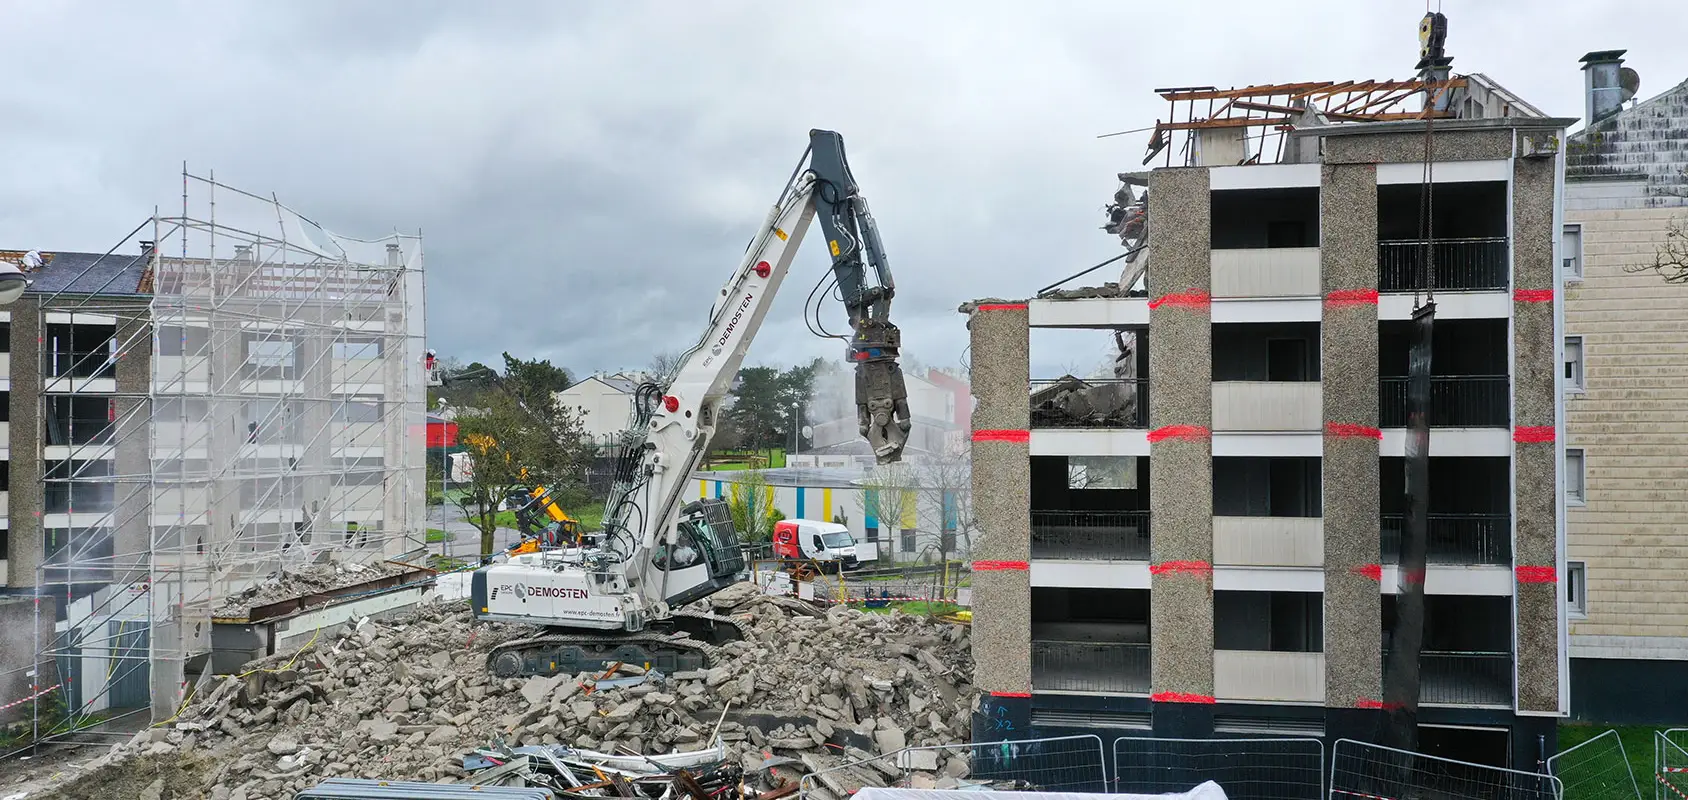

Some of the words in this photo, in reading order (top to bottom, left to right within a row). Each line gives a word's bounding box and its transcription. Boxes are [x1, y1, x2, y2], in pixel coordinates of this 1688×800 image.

[718, 293, 753, 346] DEMOSTEN
[500, 584, 513, 592] EPC
[527, 586, 588, 599] DEMOSTEN
[563, 609, 621, 619] www.epc-demosten.fr
